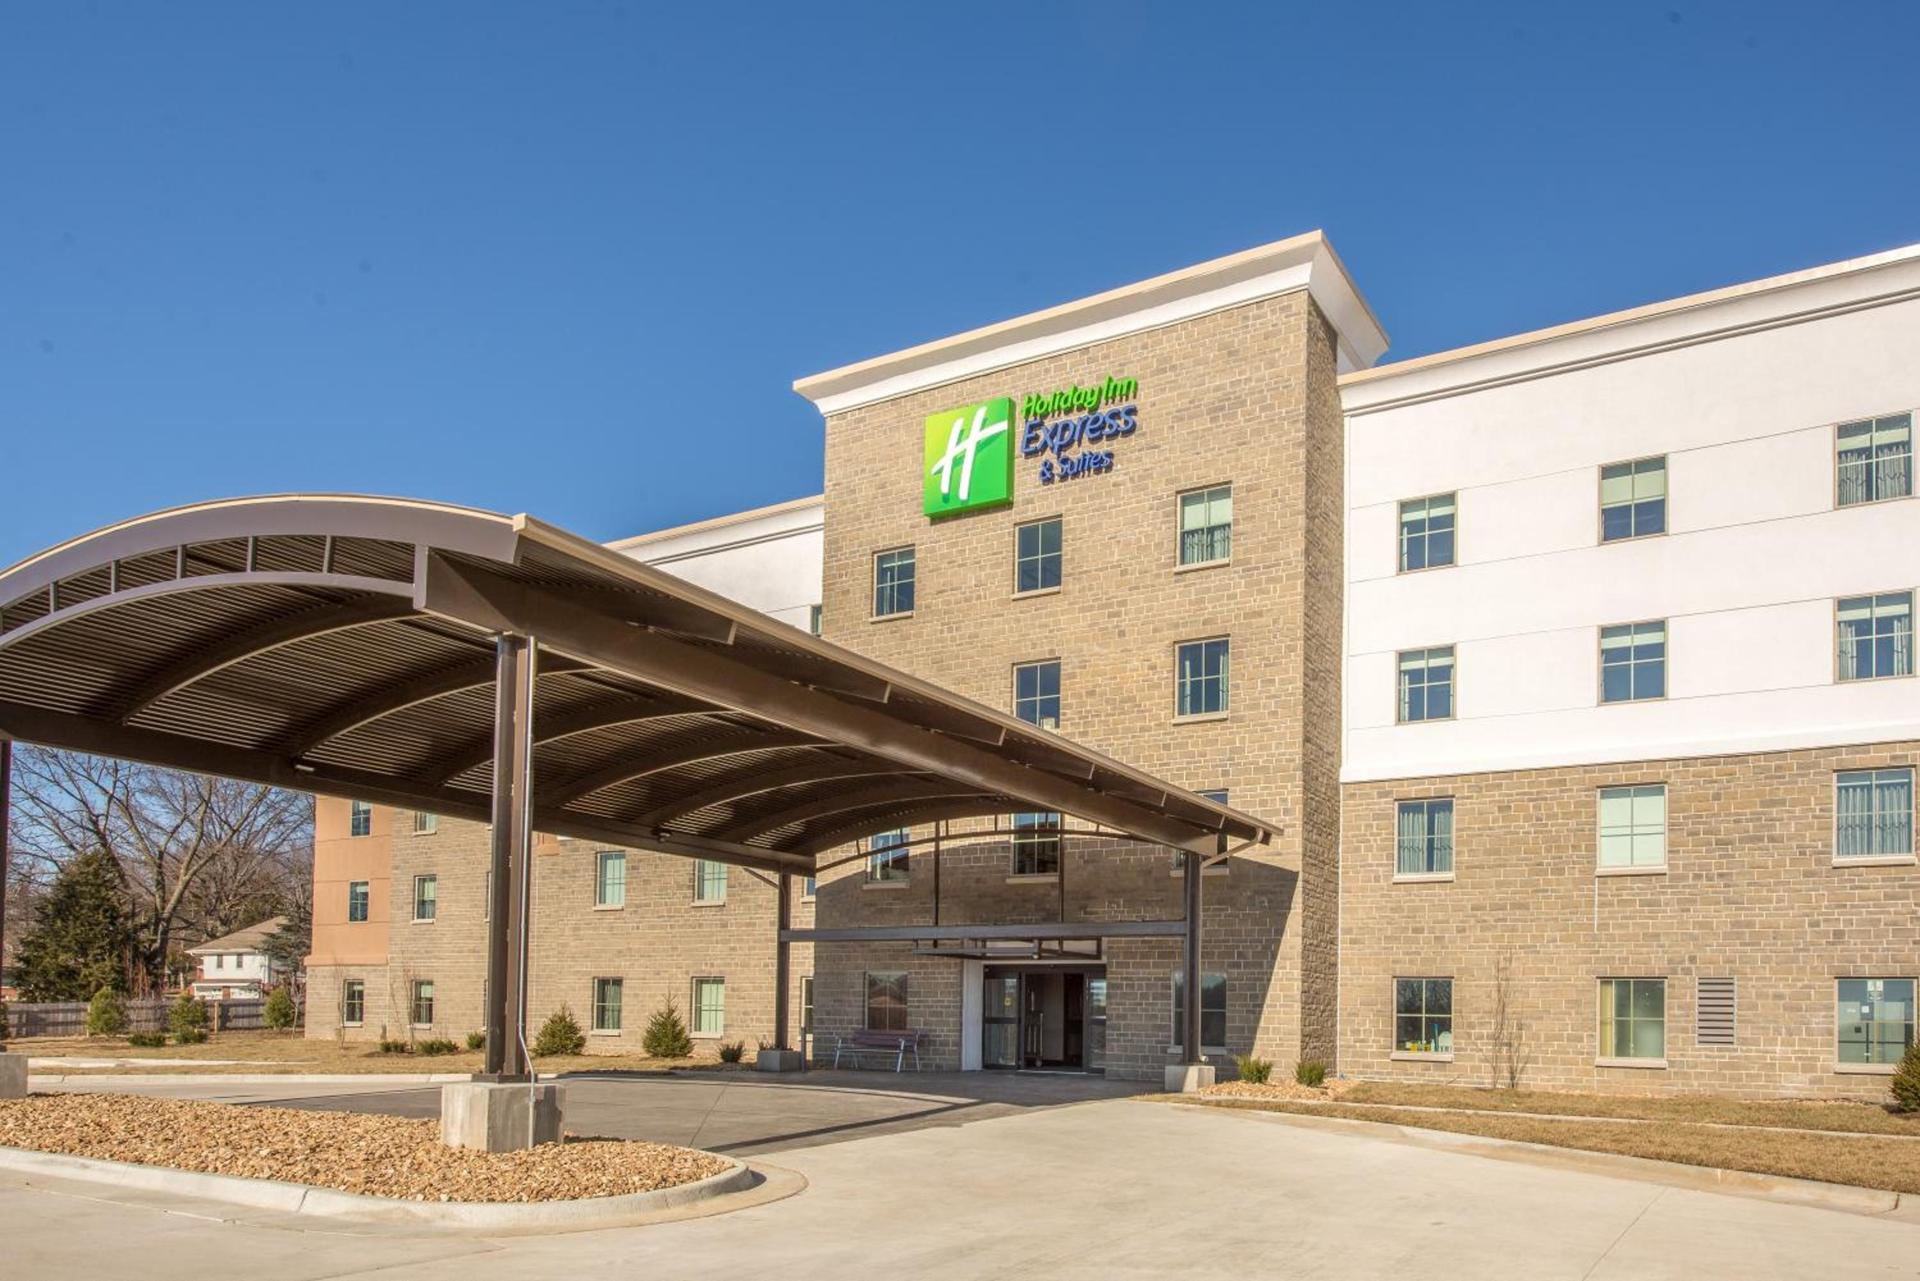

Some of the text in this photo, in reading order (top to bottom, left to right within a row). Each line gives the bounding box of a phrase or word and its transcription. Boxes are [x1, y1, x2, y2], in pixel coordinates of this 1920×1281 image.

[1021, 375, 1138, 418] Holiday Inn
[1021, 404, 1138, 457] Express
[1039, 451, 1114, 484] & Suites
